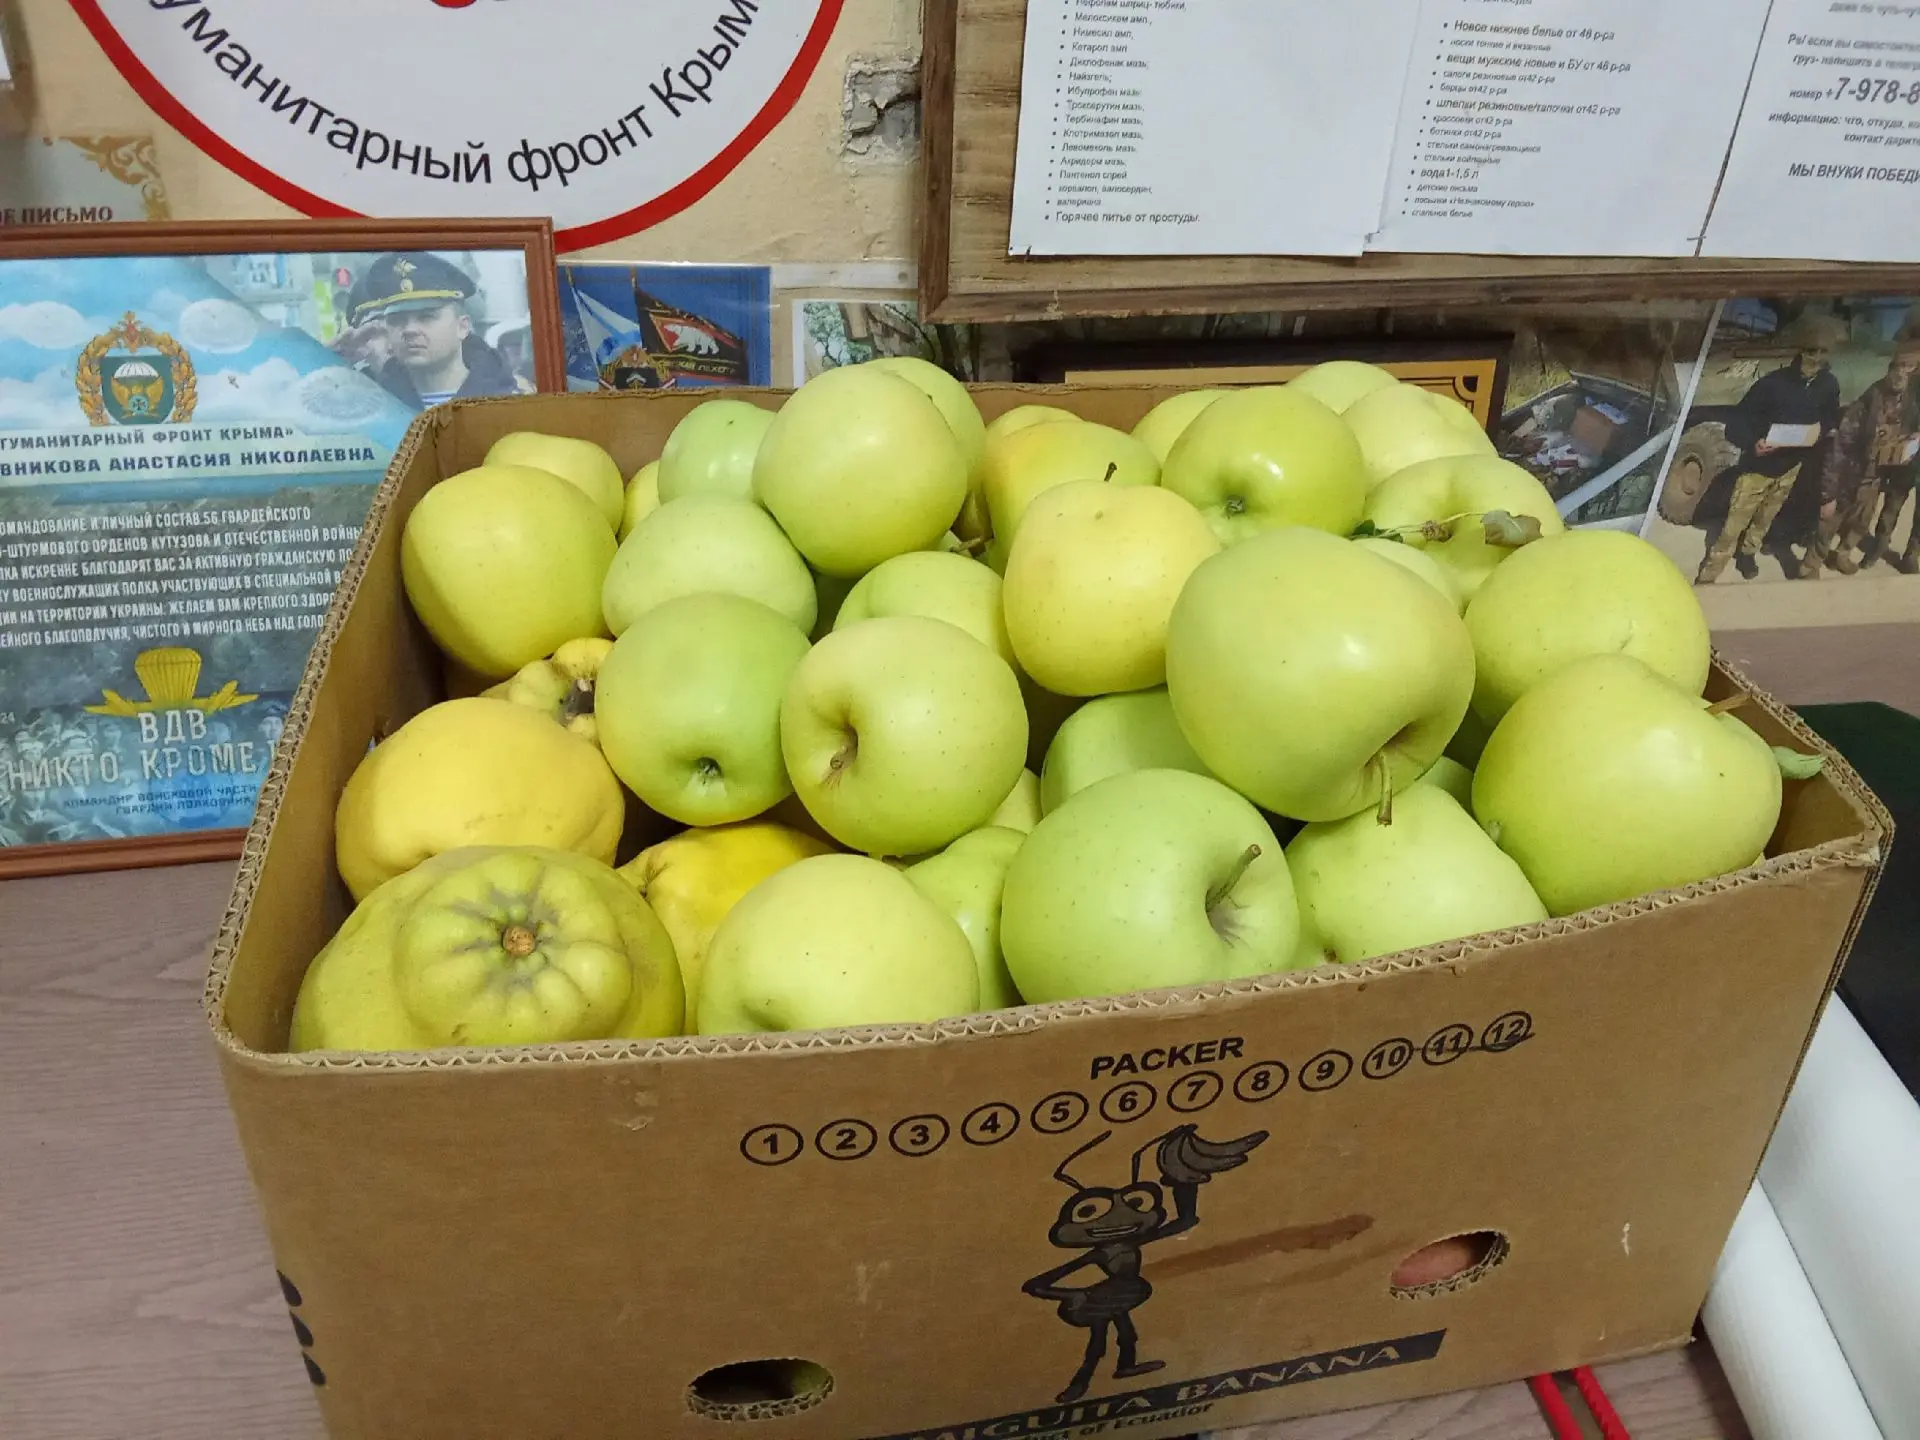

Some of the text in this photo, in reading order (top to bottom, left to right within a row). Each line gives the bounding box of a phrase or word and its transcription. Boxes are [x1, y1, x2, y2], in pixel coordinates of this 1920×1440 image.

[1455, 20, 1487, 32] Новое
[507, 104, 653, 191] фронт
[1788, 163, 1814, 177] МЫ
[1817, 164, 1862, 179] ВНУКИ
[22, 206, 113, 223] ПИСЬМО
[1135, 214, 1146, 222] от
[152, 428, 212, 443] ФРОНТ
[109, 453, 231, 472] АНАСТАСИЯ
[241, 447, 375, 466] НИКОЛАЕВНА
[222, 504, 311, 523] ГВАРДЕЙСКОГО
[93, 537, 148, 553] ОРДЕНОВ
[151, 533, 210, 550] КУТУЗОВА
[213, 532, 221, 546] И
[225, 525, 319, 546] ОТЕЧЕСТВЕННОЙ
[21, 562, 79, 579] ИСКРЕННЕ
[82, 558, 151, 576] БЛАГОДАРЯТ
[154, 558, 176, 572] ВАС
[179, 556, 192, 570] ЗА
[195, 553, 252, 570] АКТИВНУЮ
[256, 549, 335, 567] ГРАЖДАНСКУЮ
[12, 582, 120, 602] ВОЕННОСЛУЖАЩИХ
[122, 579, 159, 595] ПОЛКА
[161, 576, 242, 593] УЧАСТВУЮЩИХ
[255, 568, 331, 588] СПЕЦИАЛЬНОЙ
[20, 609, 35, 624] НА
[37, 605, 108, 623] ТЕРРИТОРИИ
[169, 599, 215, 615] ЖЕЛАЕМ
[218, 597, 240, 611] ВАМ
[244, 593, 297, 610] КРЕПКОГО
[132, 622, 179, 639] ЧИСТОГО
[274, 615, 295, 631] НАД
[138, 709, 207, 745] ВДВ
[141, 741, 256, 780] КРОМЕ
[1090, 1037, 1244, 1080] PACKER
[1176, 1346, 1400, 1401] BANANA
